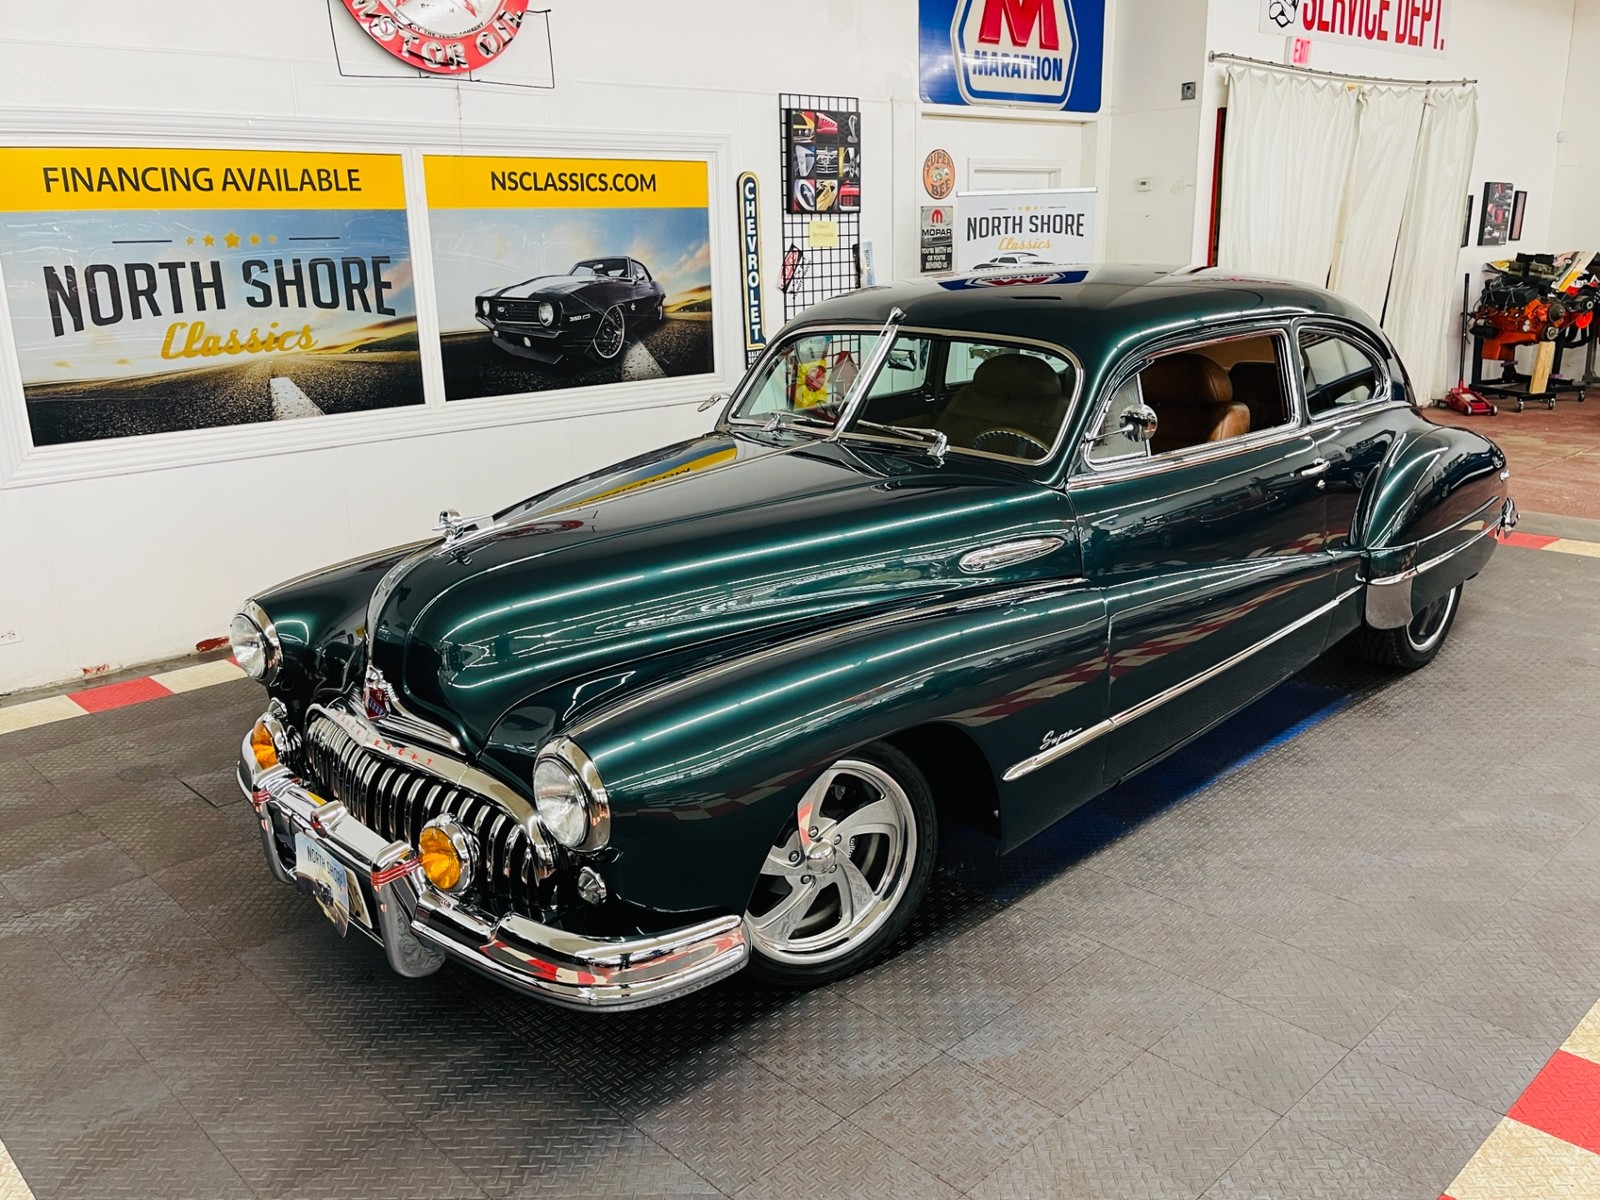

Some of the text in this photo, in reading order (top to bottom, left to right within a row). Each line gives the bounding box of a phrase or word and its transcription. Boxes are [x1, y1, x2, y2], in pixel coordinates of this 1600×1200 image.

[475, 9, 524, 59] OIL
[1292, 38, 1313, 65] EXIT
[973, 50, 1063, 82] MARATHON
[926, 151, 953, 178] SUPER
[42, 167, 362, 193] FINANCING AVAILABLE
[490, 171, 657, 192] NSCLASSICS.COM
[930, 178, 951, 197] BEE
[922, 228, 952, 237] MOPAR
[967, 213, 1085, 242] NORTH SHORE
[997, 237, 1053, 251] Classics
[744, 182, 761, 341] CHEVROLET
[43, 256, 396, 338] NORTH SHORE
[160, 321, 319, 361] Classics
[1039, 727, 1083, 750] Super
[374, 739, 433, 766] EIGHT
